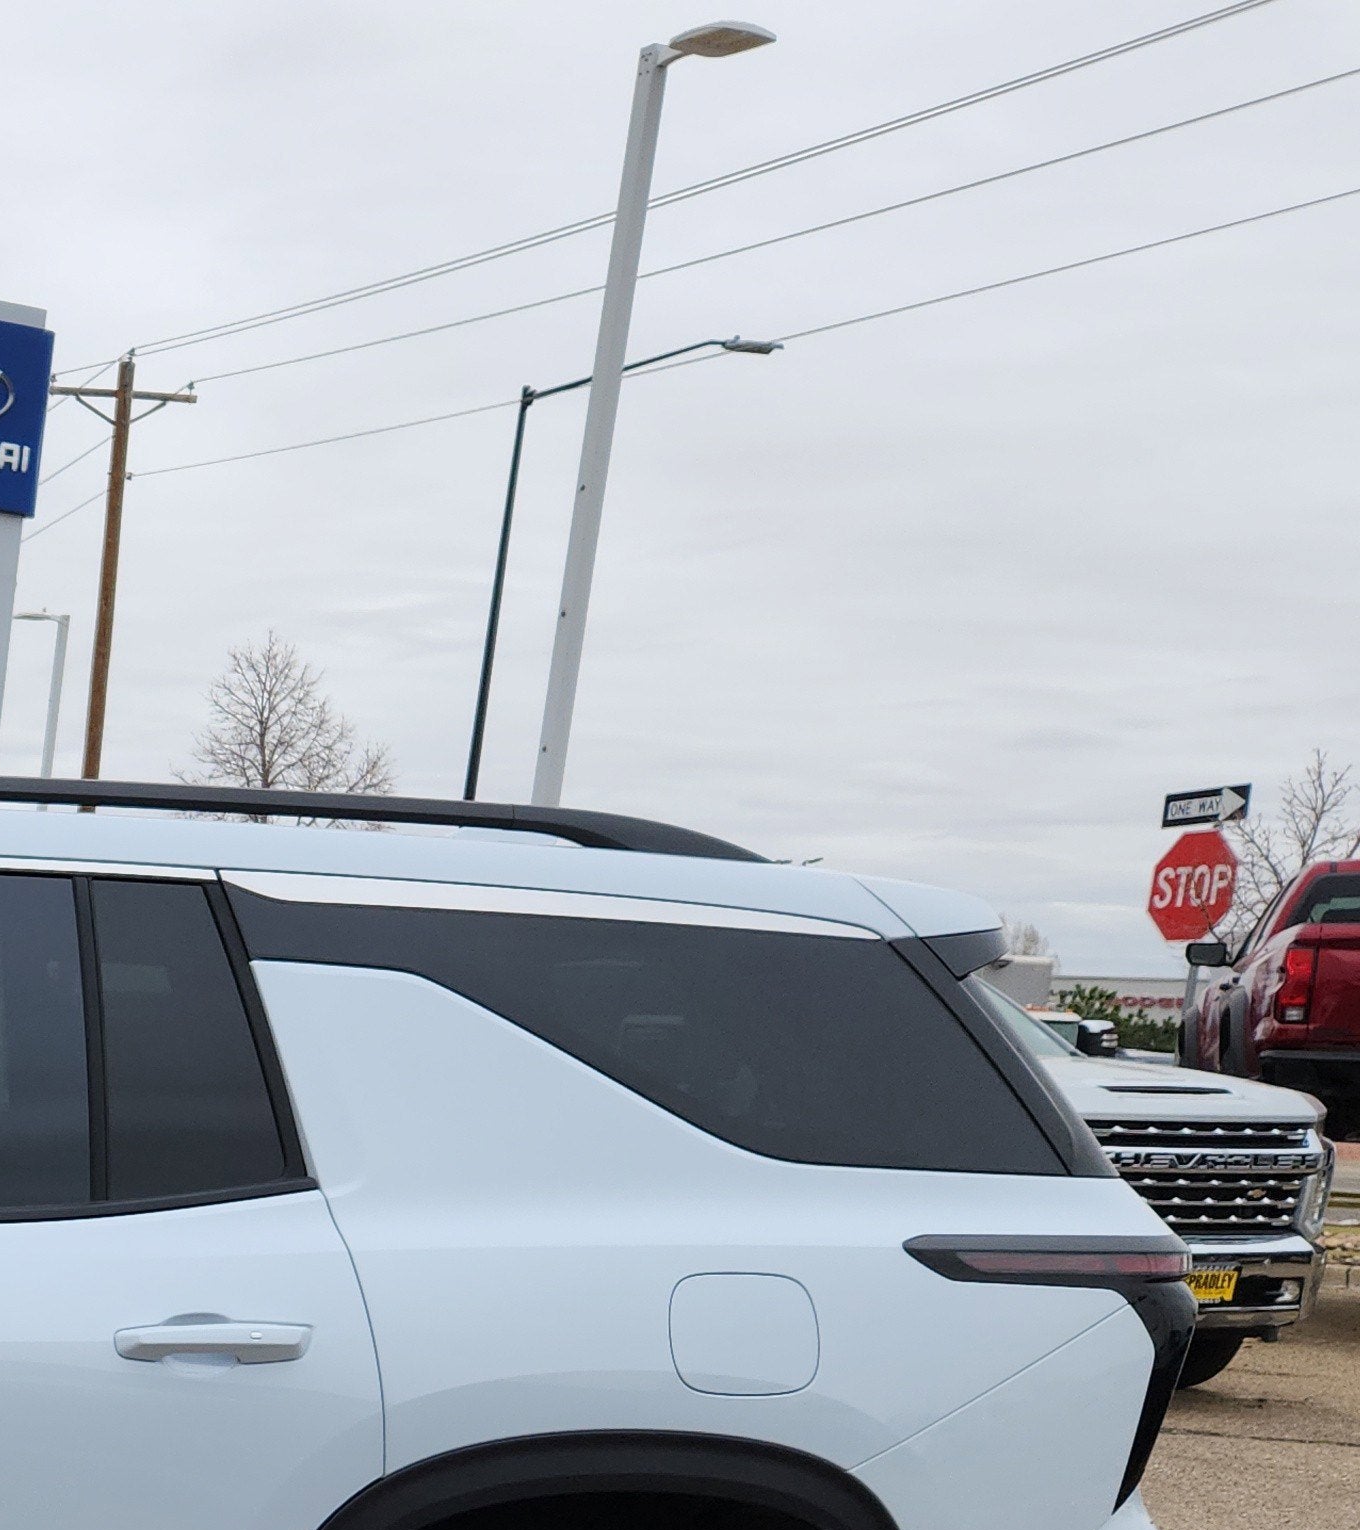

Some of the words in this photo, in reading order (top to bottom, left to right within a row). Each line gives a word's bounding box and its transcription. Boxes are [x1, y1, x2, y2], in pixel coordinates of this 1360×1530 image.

[1169, 799, 1193, 818] ONE
[1198, 797, 1221, 814] WAY
[1152, 863, 1232, 909] STOP
